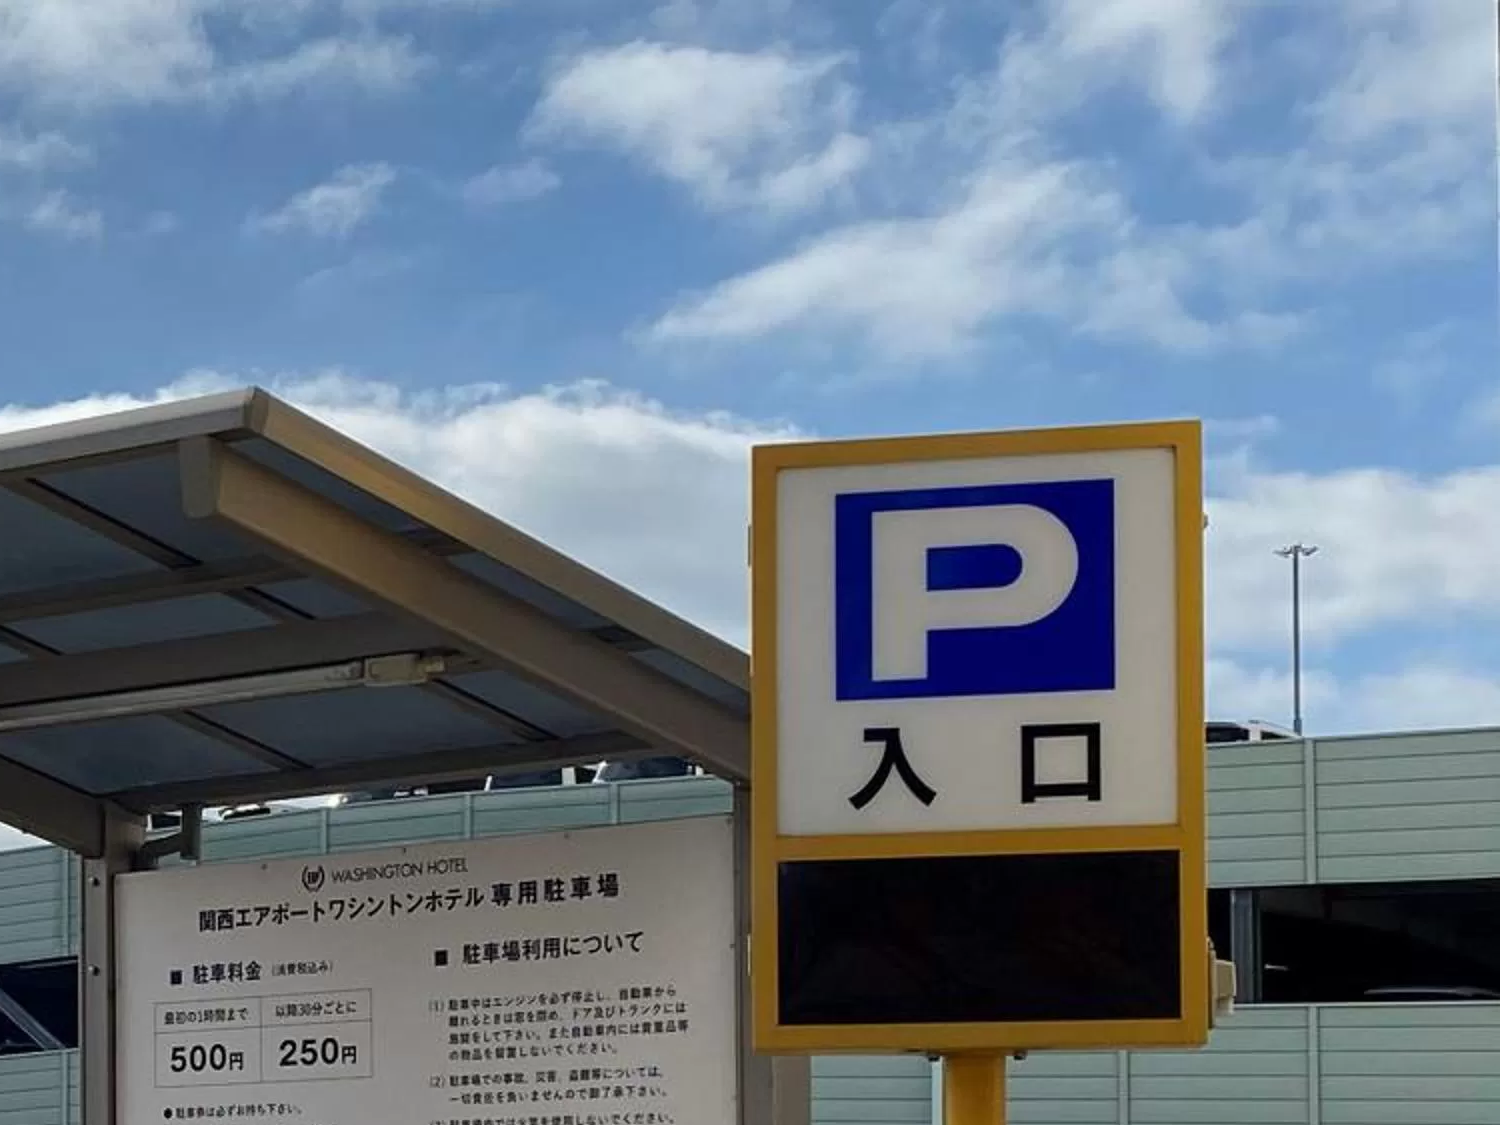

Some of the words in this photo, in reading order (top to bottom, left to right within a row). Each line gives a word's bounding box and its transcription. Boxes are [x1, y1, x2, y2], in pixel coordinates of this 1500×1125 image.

[872, 503, 1079, 682] P
[849, 722, 1101, 811] 入口
[331, 862, 423, 883] WASHINGTON
[427, 857, 468, 874] HOTEL
[199, 886, 485, 932] 関西エアポートワシントンホテル
[490, 872, 620, 908] 専用駐車場
[462, 931, 644, 965] 駐車場利用について
[193, 960, 262, 985] 駐車料金
[170, 1043, 244, 1073] 500円
[279, 1037, 357, 1067] 250円
